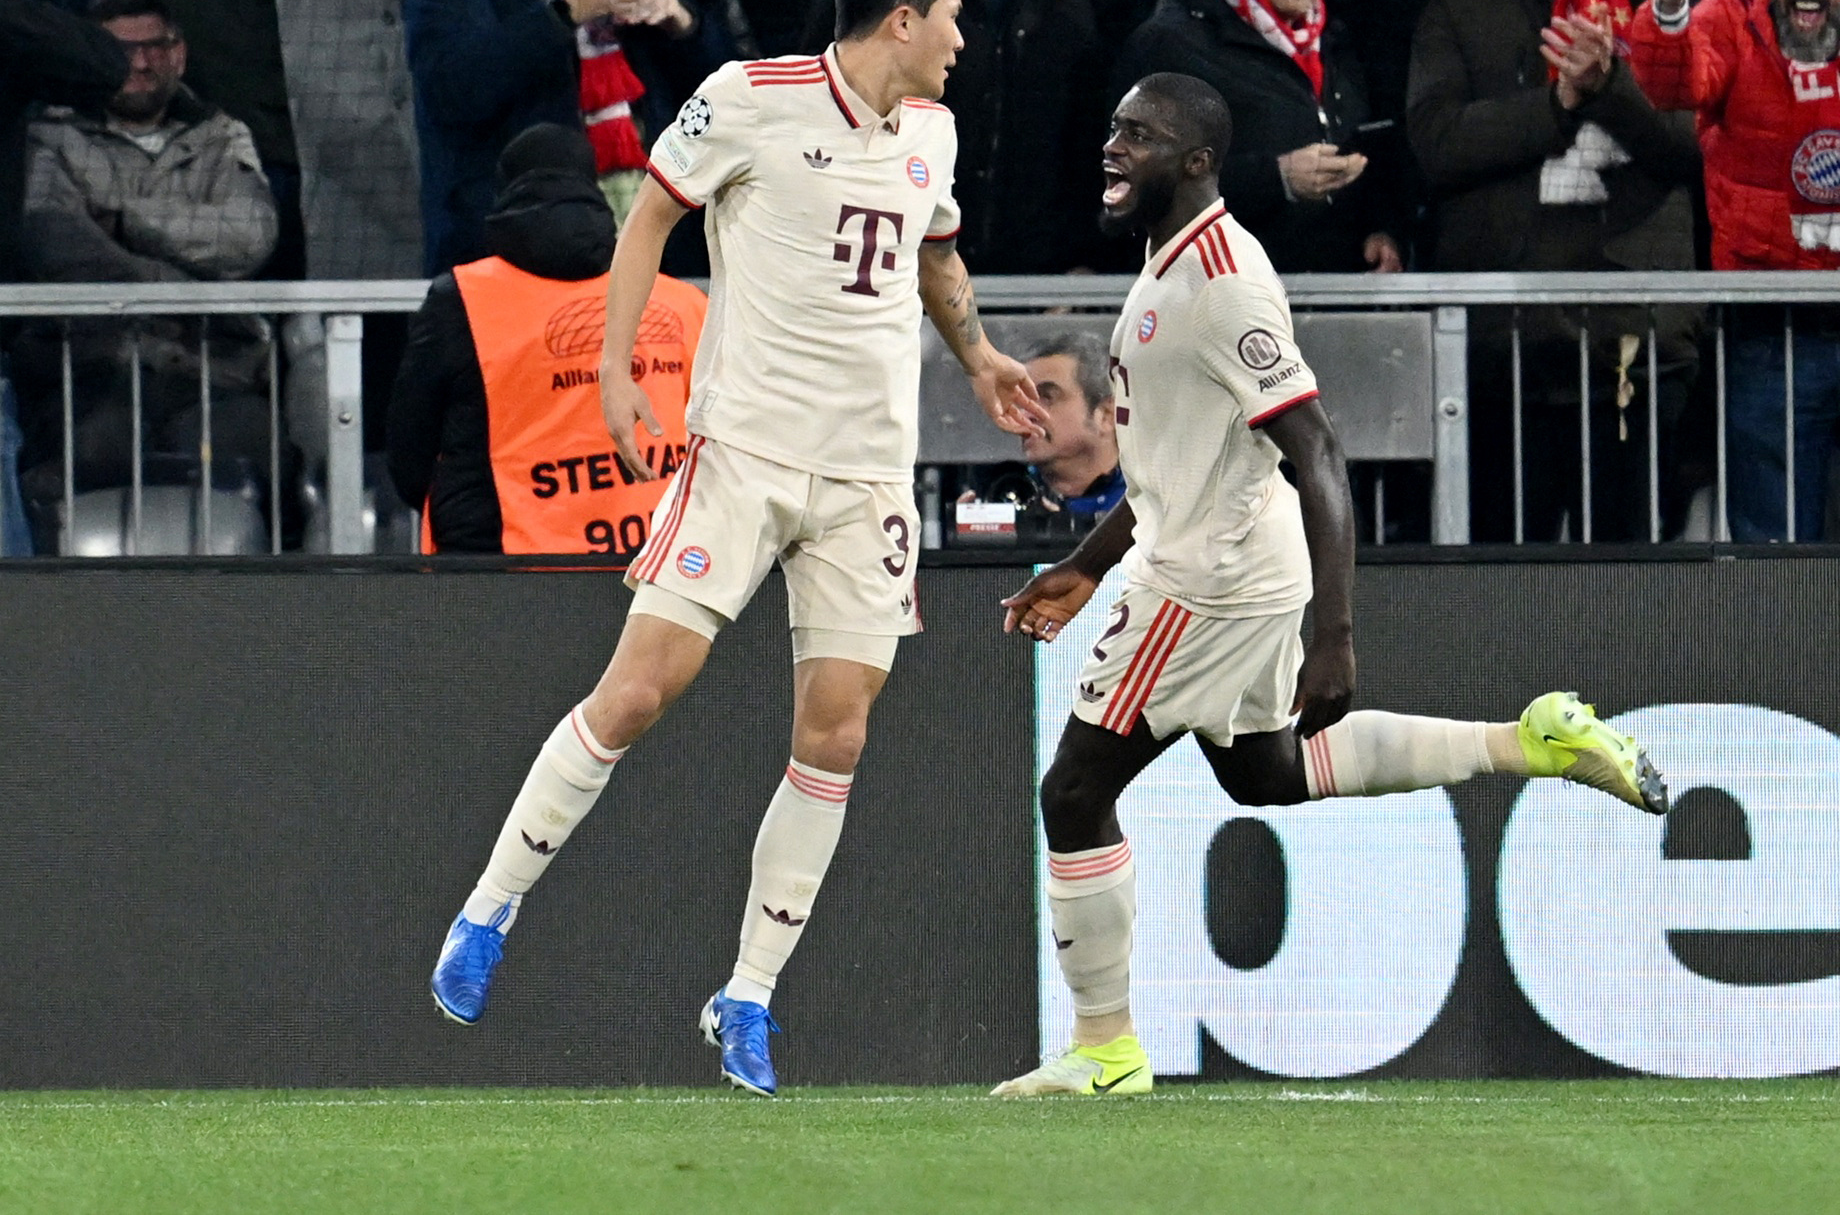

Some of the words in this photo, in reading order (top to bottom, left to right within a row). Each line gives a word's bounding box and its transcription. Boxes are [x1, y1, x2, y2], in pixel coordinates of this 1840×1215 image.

[832, 202, 904, 299] T
[551, 368, 600, 392] Allia
[1257, 361, 1303, 393] Allianz
[882, 514, 910, 578] 3
[1092, 603, 1130, 663] 2
